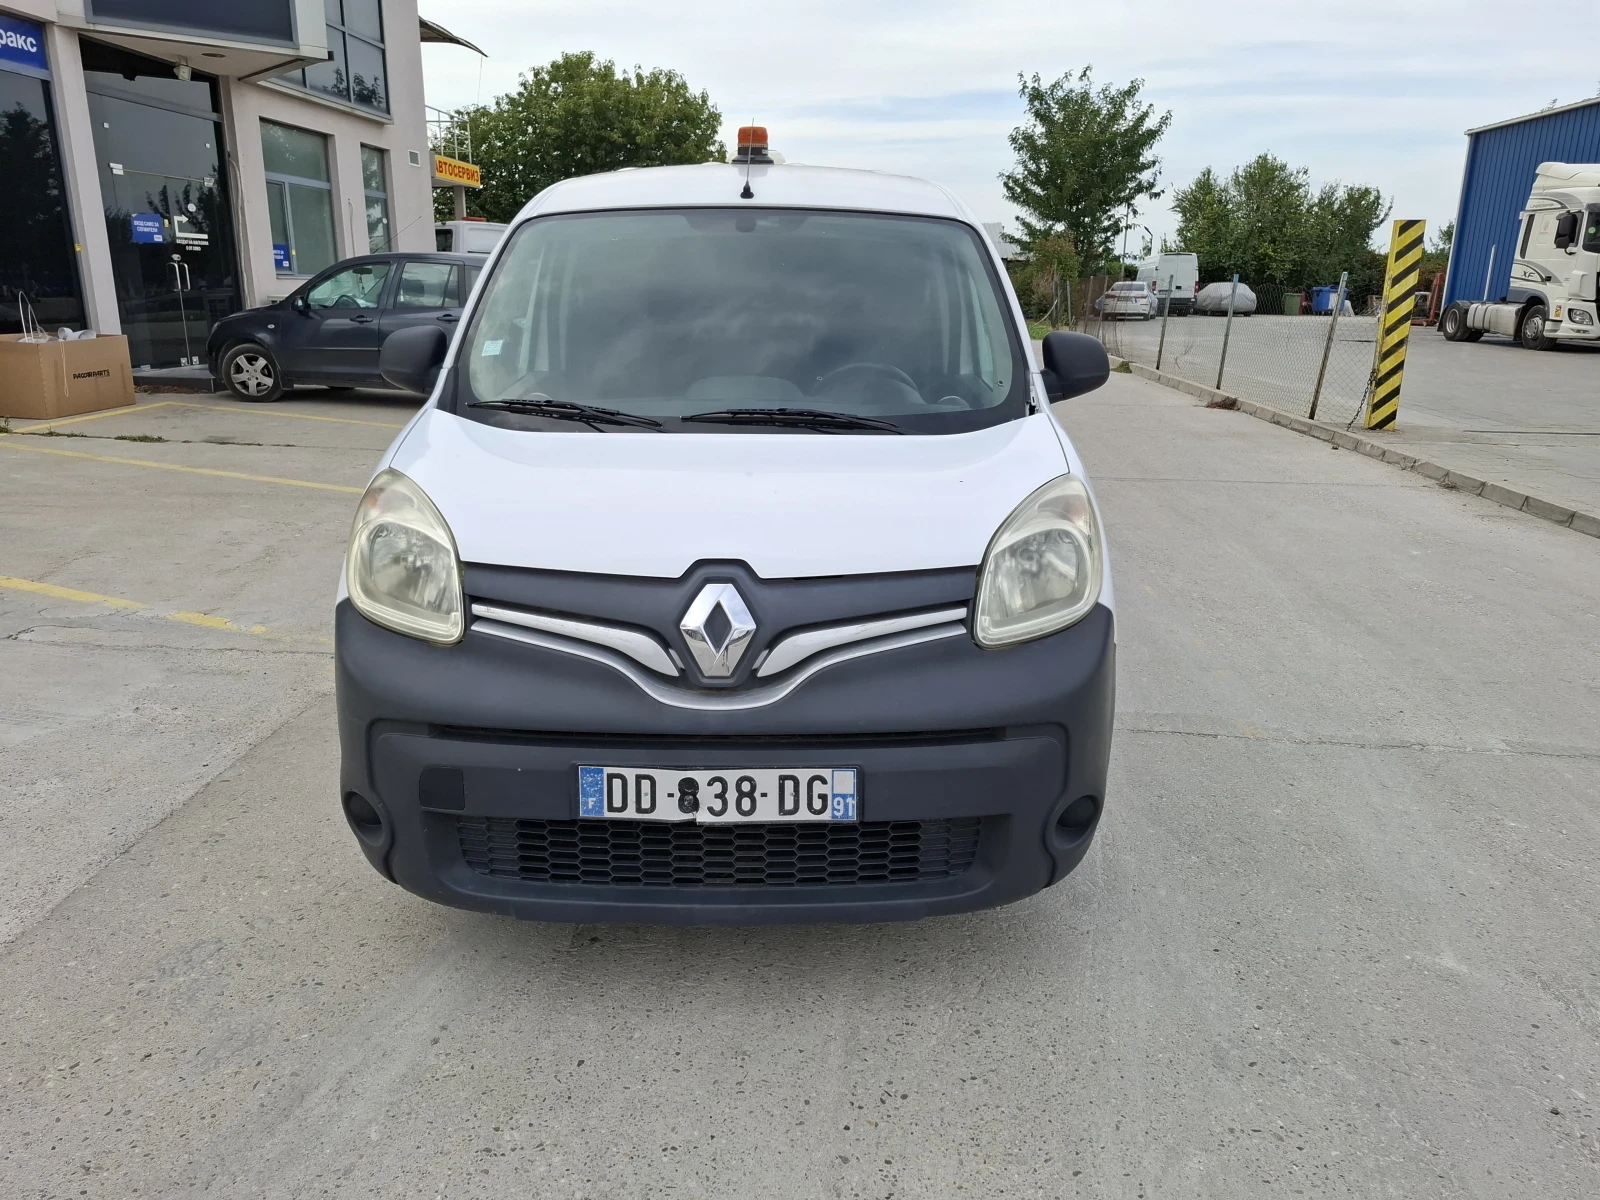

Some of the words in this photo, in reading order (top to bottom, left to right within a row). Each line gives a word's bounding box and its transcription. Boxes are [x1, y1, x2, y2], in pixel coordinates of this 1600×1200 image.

[1522, 270, 1535, 279] XF
[588, 797, 596, 809] F
[833, 797, 855, 817] 91
